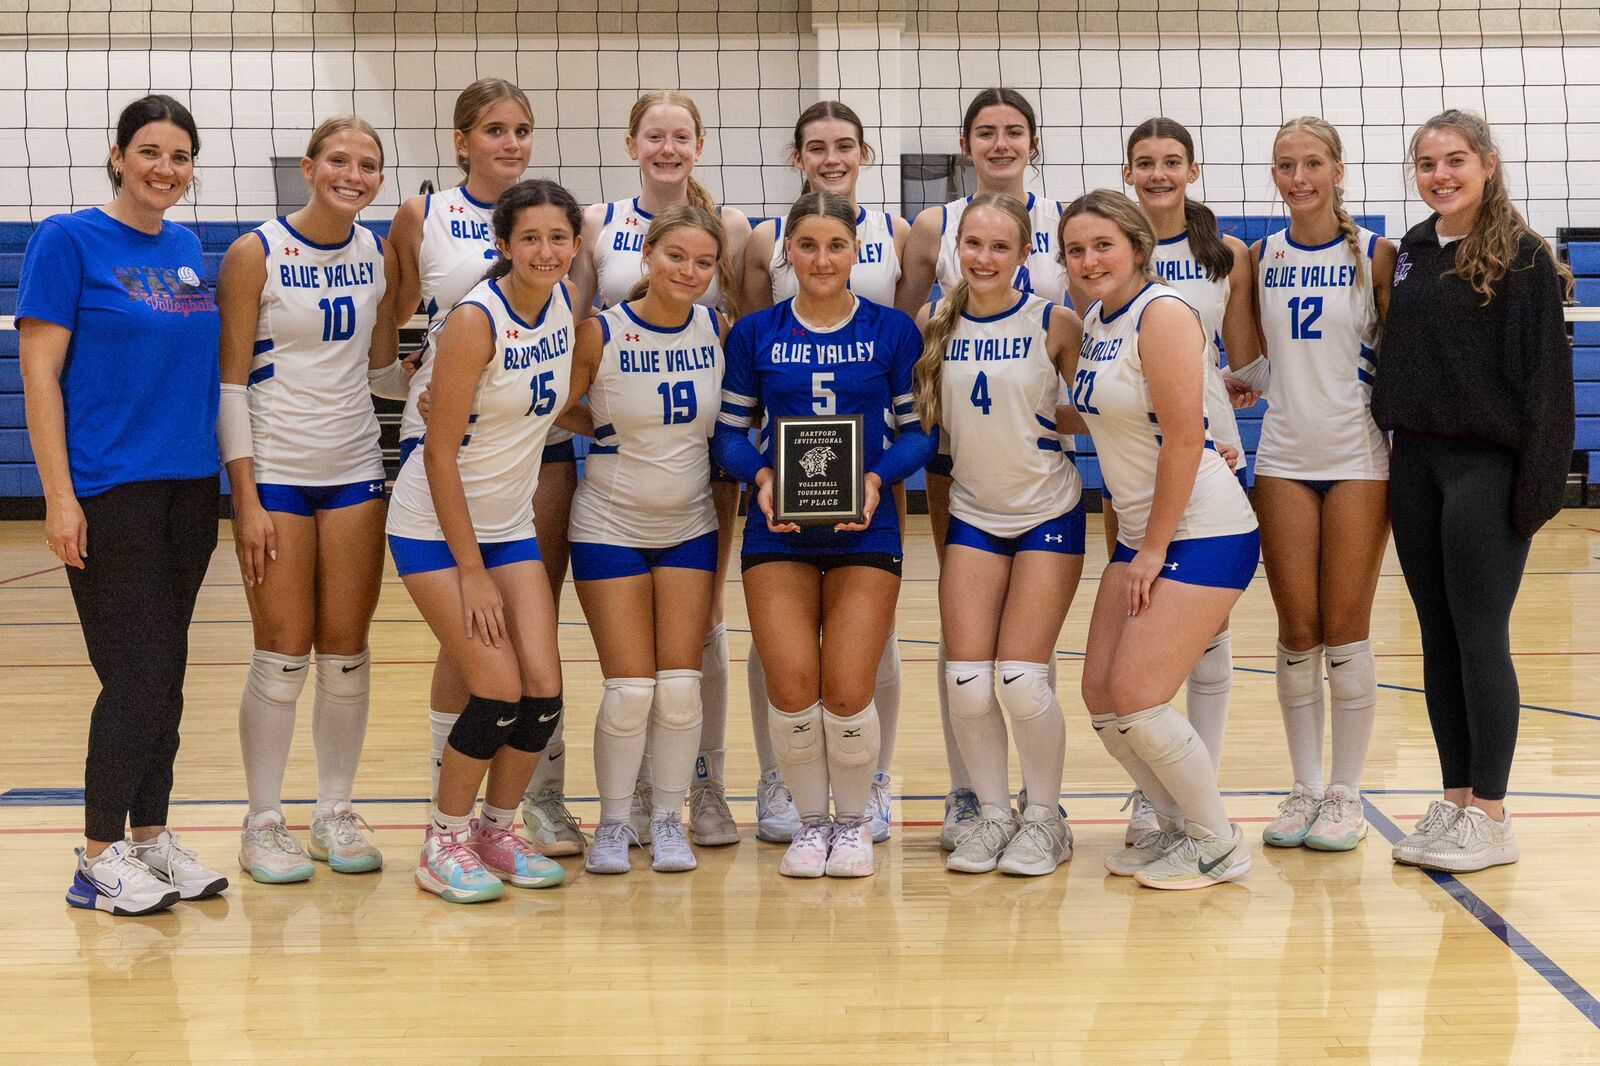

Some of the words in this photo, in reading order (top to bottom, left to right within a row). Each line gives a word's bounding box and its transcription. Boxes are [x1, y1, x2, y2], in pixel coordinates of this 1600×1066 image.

[450, 219, 490, 242] BLUE
[613, 231, 646, 252] BLU
[858, 242, 883, 264] LEY
[280, 264, 320, 289] BLUE
[323, 261, 374, 287] VALLEY
[1155, 259, 1208, 281] VALLE
[1264, 265, 1297, 288] BLUE
[1301, 264, 1356, 287] VALLEY
[319, 295, 356, 341] 10
[1288, 296, 1323, 340] 12
[534, 325, 569, 364] VALLEY
[771, 342, 811, 365] BLUE
[815, 340, 875, 365] VALLEY
[943, 338, 970, 362] LUE
[974, 336, 1033, 362] VALLEY
[620, 349, 660, 373] BLUE
[665, 345, 715, 373] VALLEY
[524, 370, 557, 416] 15
[657, 379, 697, 425] 19
[811, 372, 837, 416] 5
[970, 371, 992, 415] 4
[1073, 369, 1101, 416] 22
